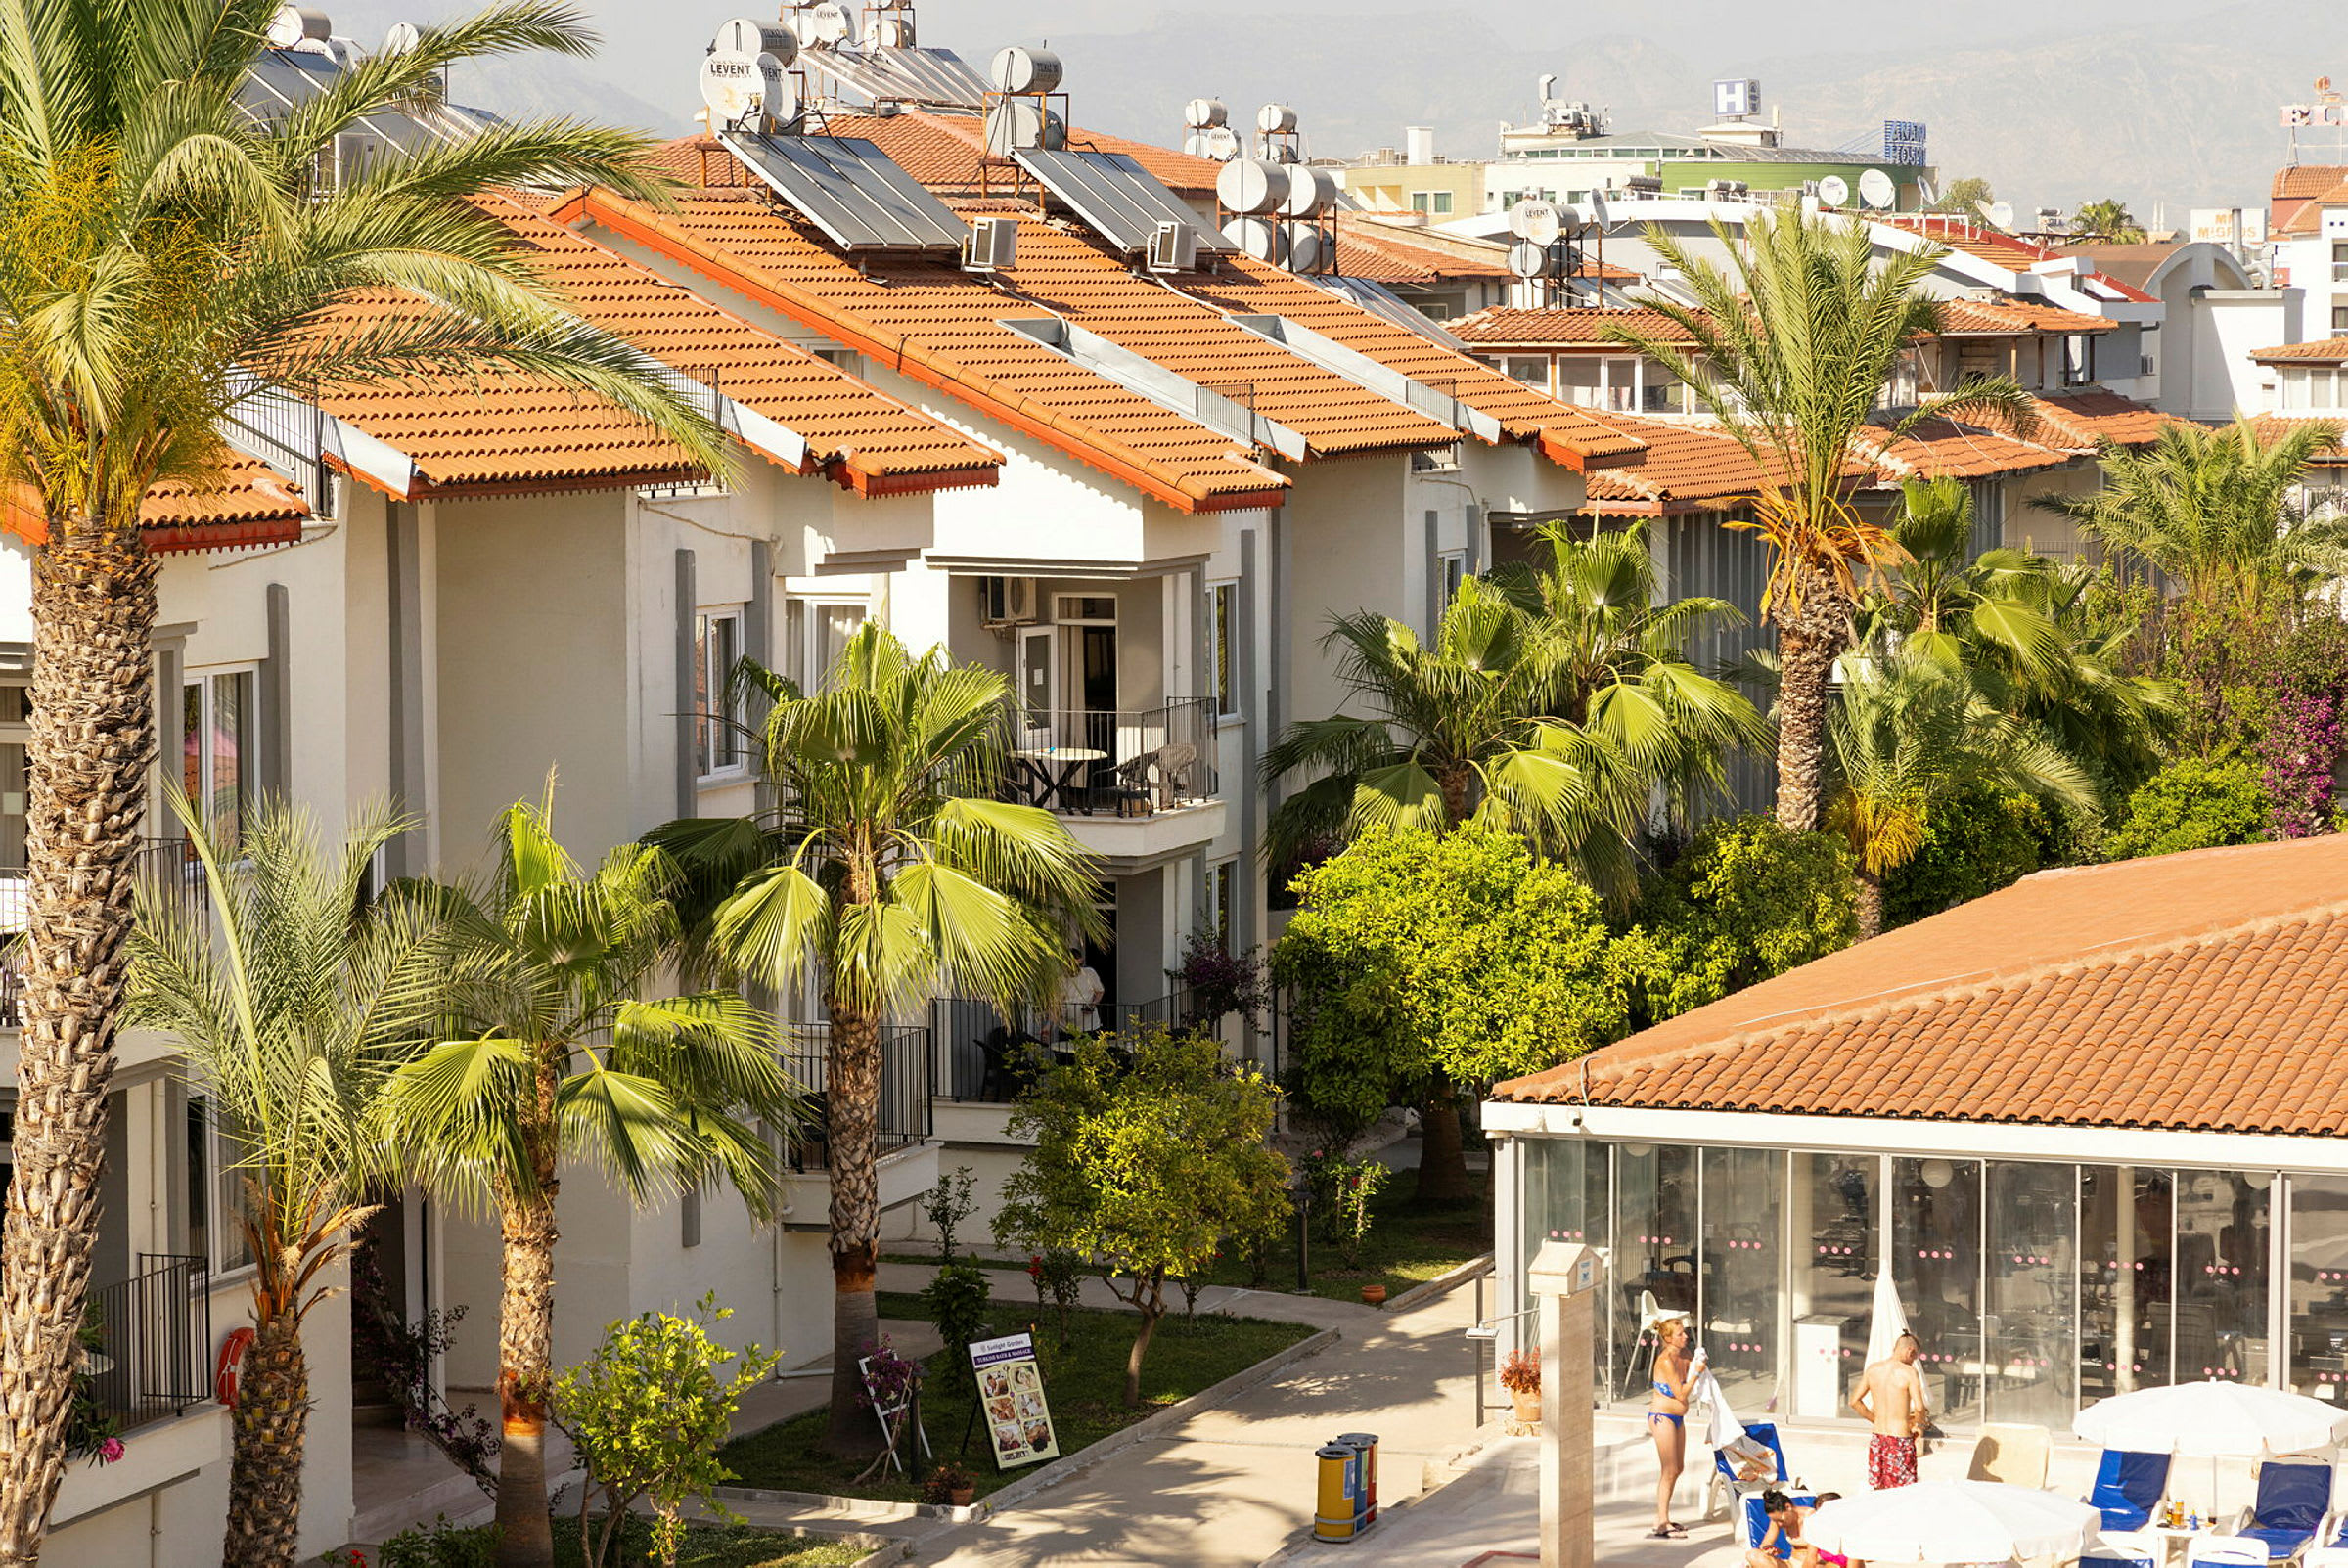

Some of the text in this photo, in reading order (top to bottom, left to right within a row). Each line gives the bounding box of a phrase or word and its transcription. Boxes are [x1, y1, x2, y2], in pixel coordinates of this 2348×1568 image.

[710, 64, 751, 74] LEVENT
[1717, 82, 1744, 112] H
[1525, 208, 1549, 217] LEVENT
